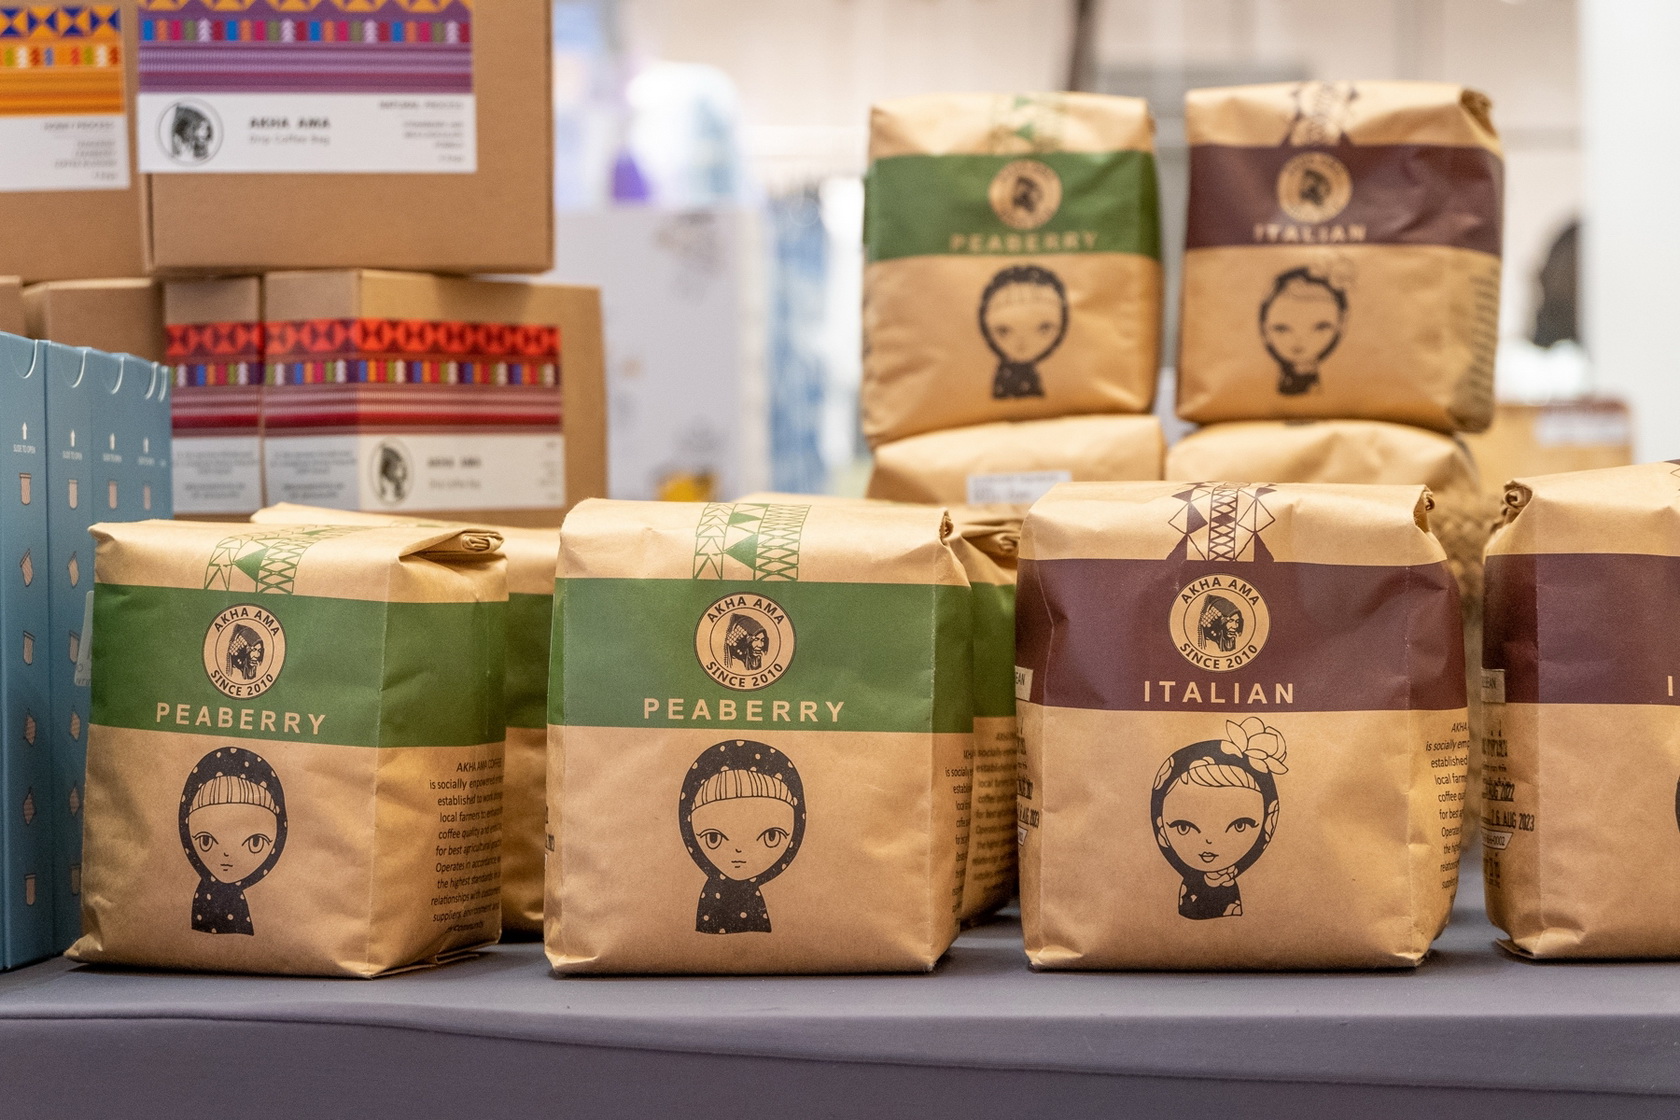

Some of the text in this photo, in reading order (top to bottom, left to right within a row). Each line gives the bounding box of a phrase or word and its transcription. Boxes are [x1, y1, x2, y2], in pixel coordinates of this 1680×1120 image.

[1253, 223, 1366, 242] ITALIAN
[950, 231, 1098, 252] PEABERRY
[1181, 577, 1260, 606] AKHA AMA
[706, 596, 785, 626] AKHA AMA
[214, 607, 281, 636] AKHA AMA
[1180, 643, 1258, 669] SINCE 2010
[210, 669, 274, 696] SINCE 2010
[706, 661, 784, 688] SINCE 2010
[1144, 680, 1294, 704] ITALIAN
[644, 698, 844, 722] PEABERRY
[156, 702, 326, 735] PEABERRY
[1426, 741, 1432, 751] is
[1433, 739, 1457, 751] socially
[1431, 755, 1468, 768] established
[430, 780, 436, 789] is
[438, 778, 467, 790] socially
[1434, 773, 1451, 785] local
[438, 794, 476, 806] established
[1438, 791, 1457, 802] coffee
[440, 812, 457, 822] local
[1439, 809, 1448, 819] for
[1503, 811, 1516, 828] AUG
[1519, 813, 1535, 832] 2023
[439, 829, 461, 839] coffee
[436, 846, 447, 856] for
[448, 845, 462, 855] best
[436, 863, 464, 874] Operates
[437, 879, 448, 889] the
